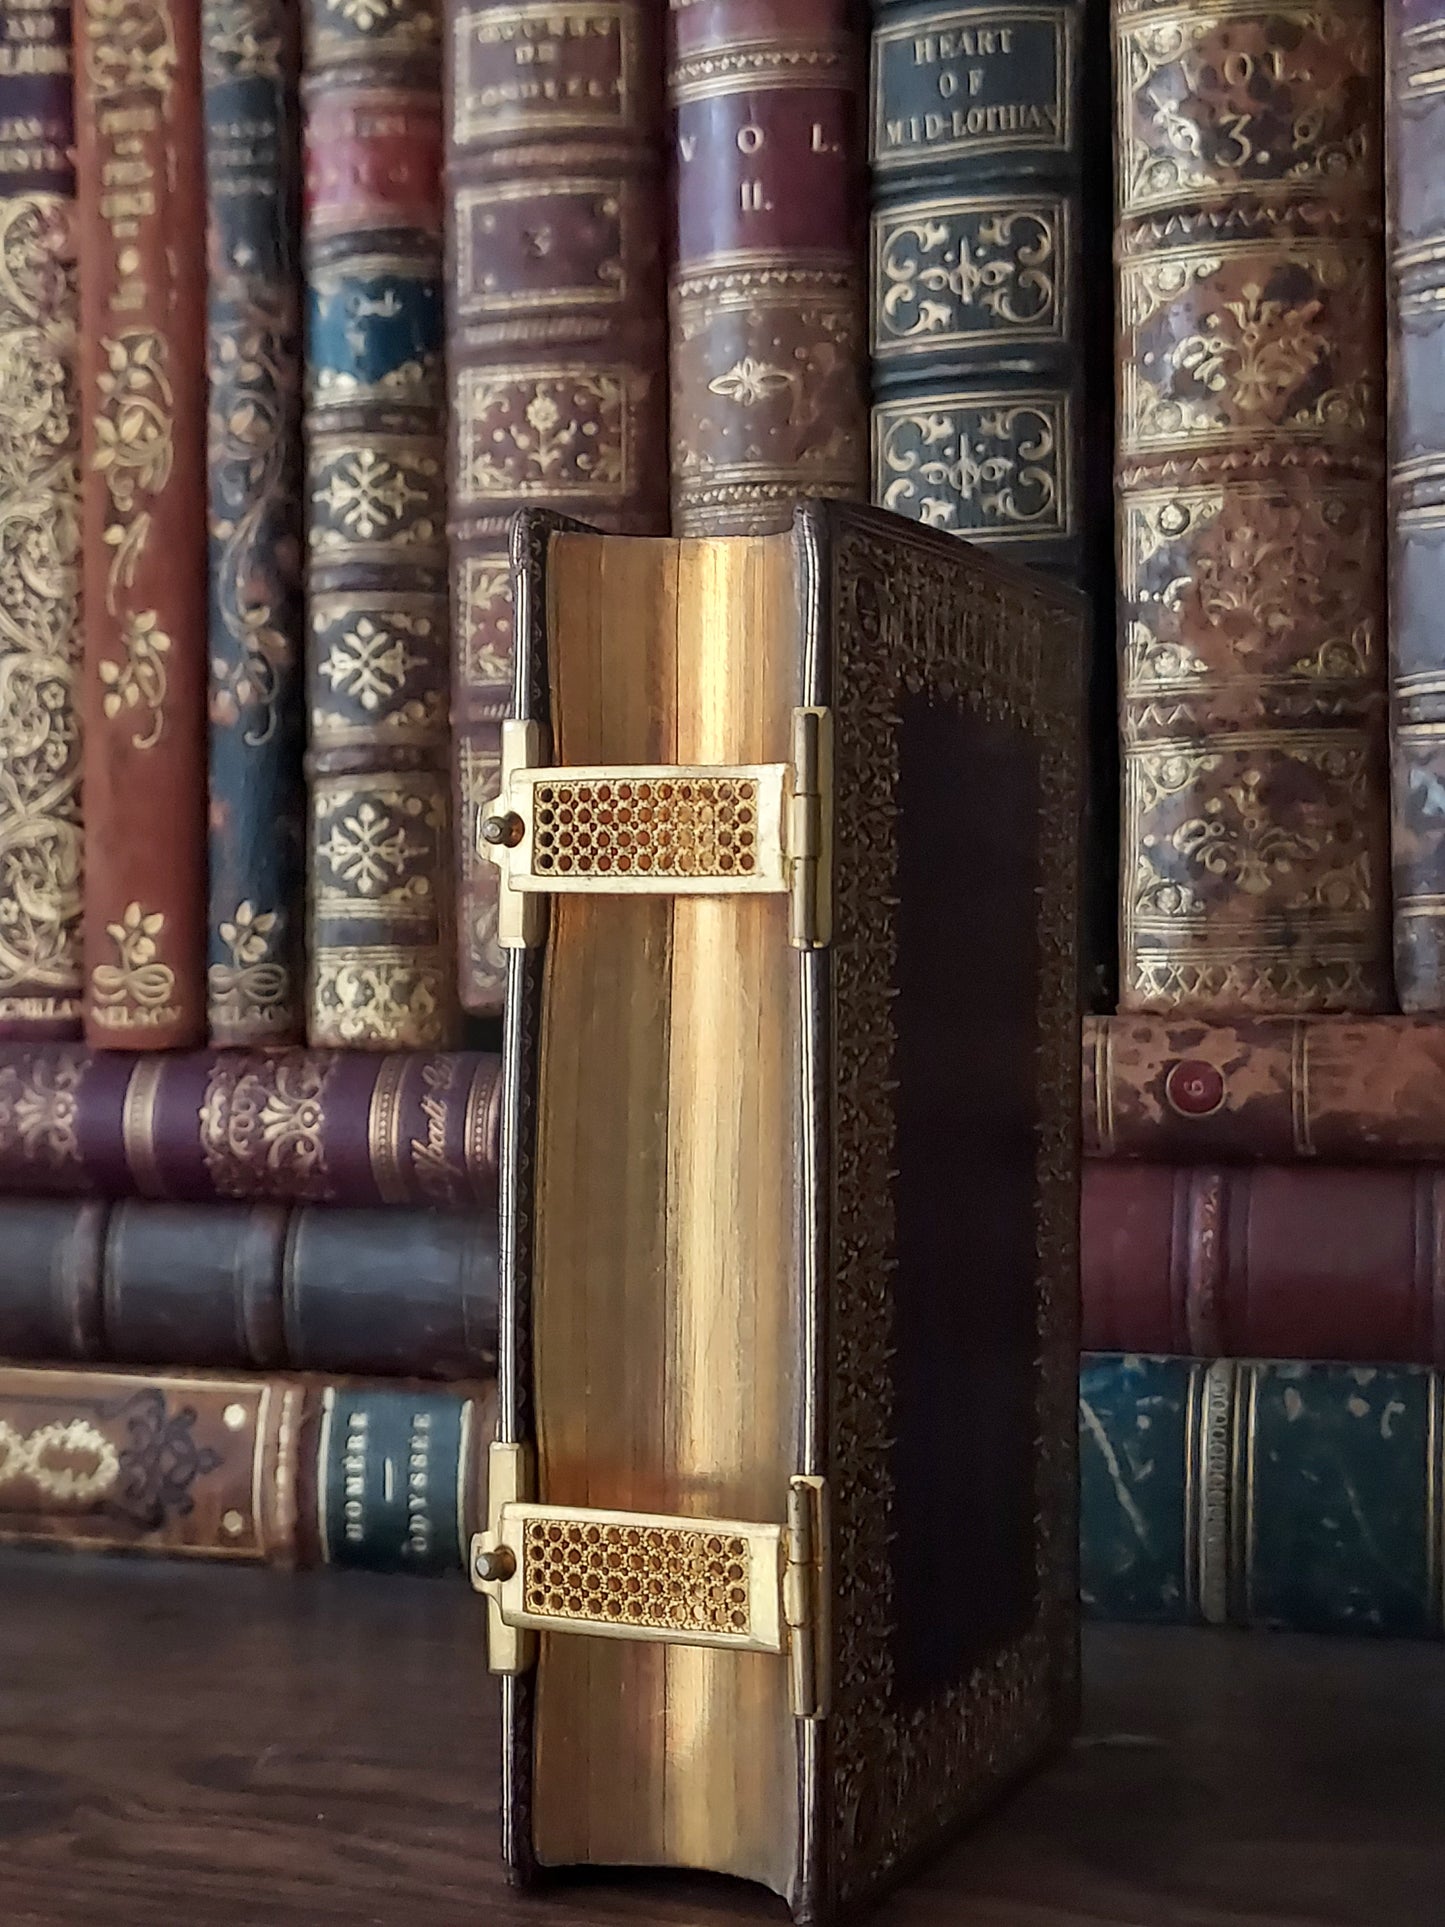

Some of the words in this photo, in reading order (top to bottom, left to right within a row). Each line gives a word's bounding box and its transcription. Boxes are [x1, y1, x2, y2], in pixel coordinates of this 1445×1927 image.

[914, 29, 1013, 66] HEART
[939, 68, 984, 99] OF
[679, 122, 839, 163] VOL.
[886, 104, 1058, 145] MID-LOTHIAN
